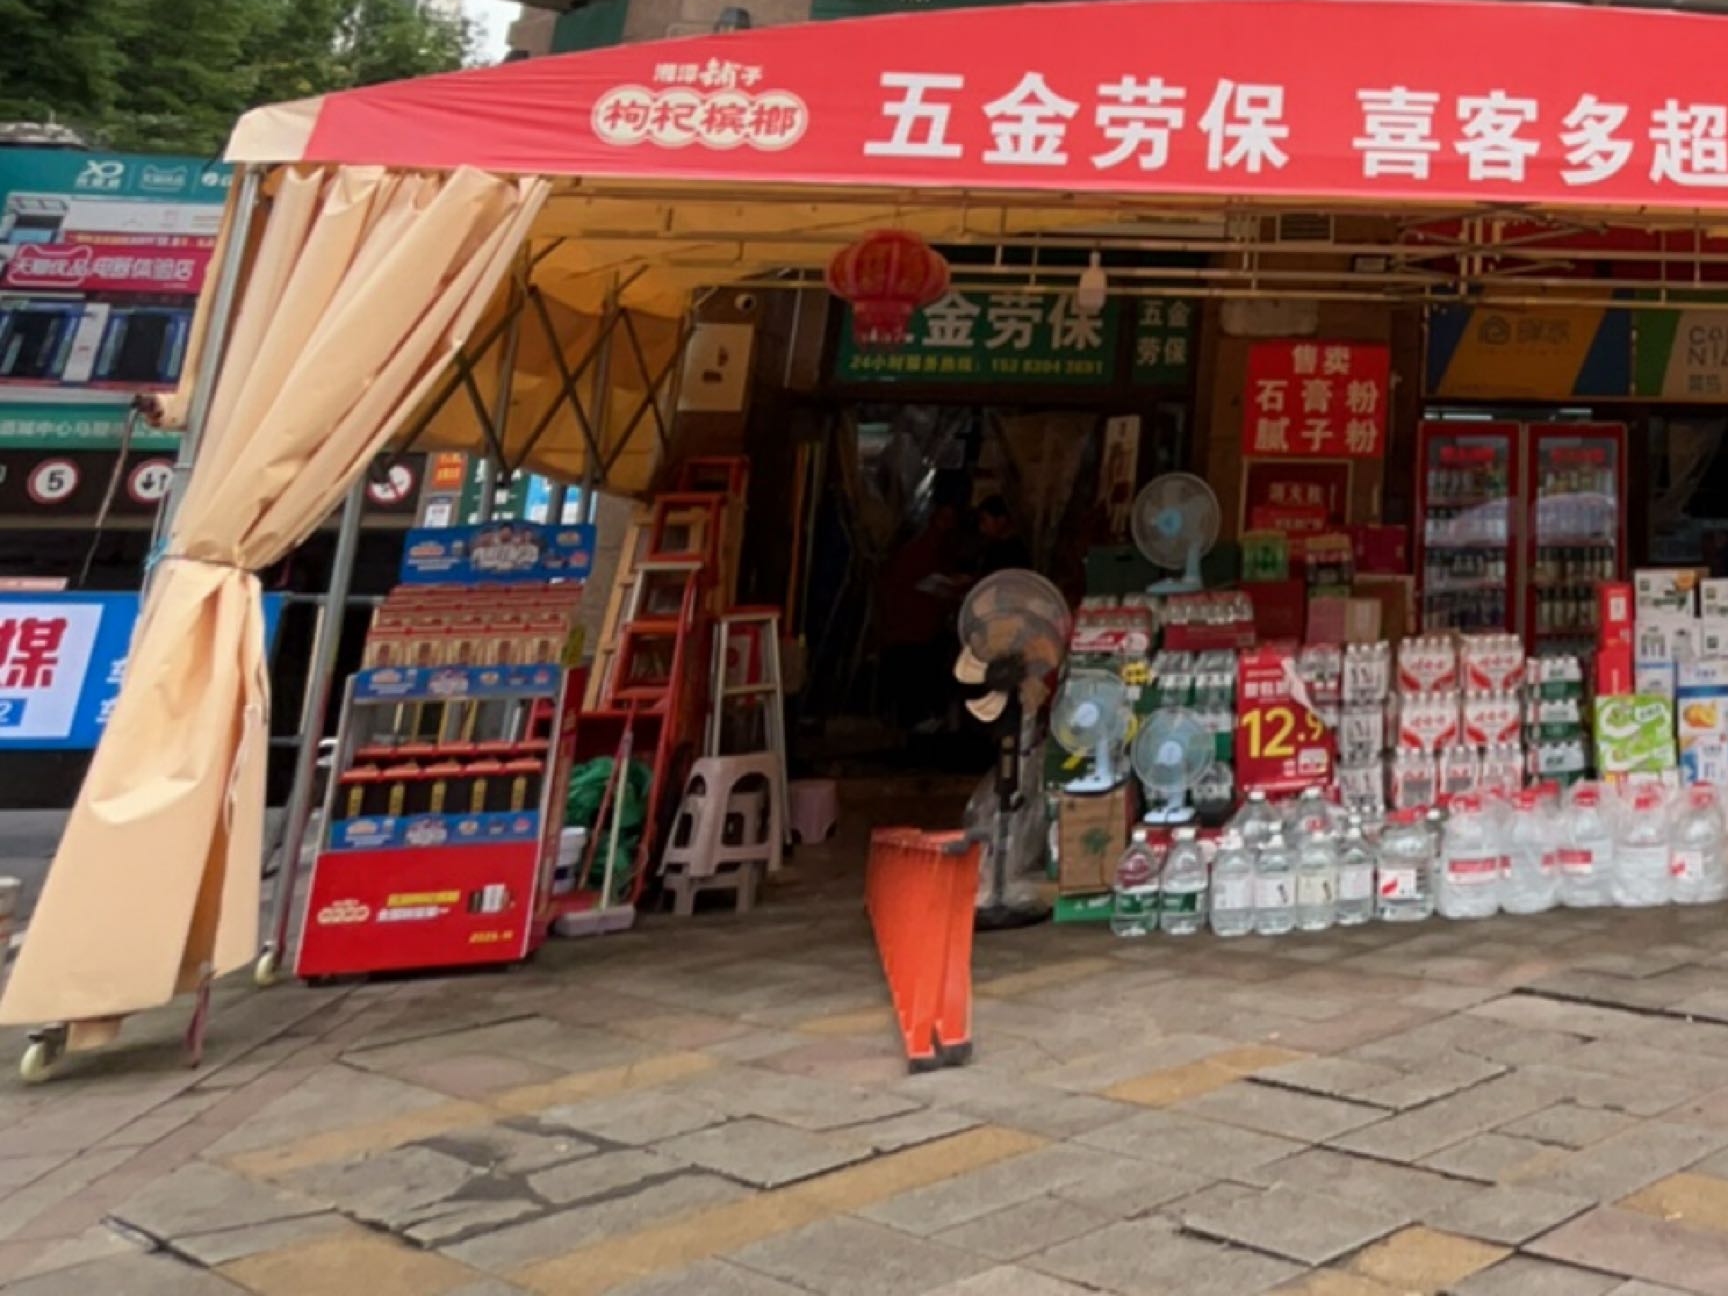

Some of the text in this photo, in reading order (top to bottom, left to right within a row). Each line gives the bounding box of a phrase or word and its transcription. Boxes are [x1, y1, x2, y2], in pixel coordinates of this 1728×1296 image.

[602, 98, 801, 139] 枸杞槟榔
[862, 70, 1290, 174] 五金劳保
[864, 290, 1104, 351] 金劳保
[1253, 378, 1382, 415] 石膏粉
[47, 470, 65, 493] 5
